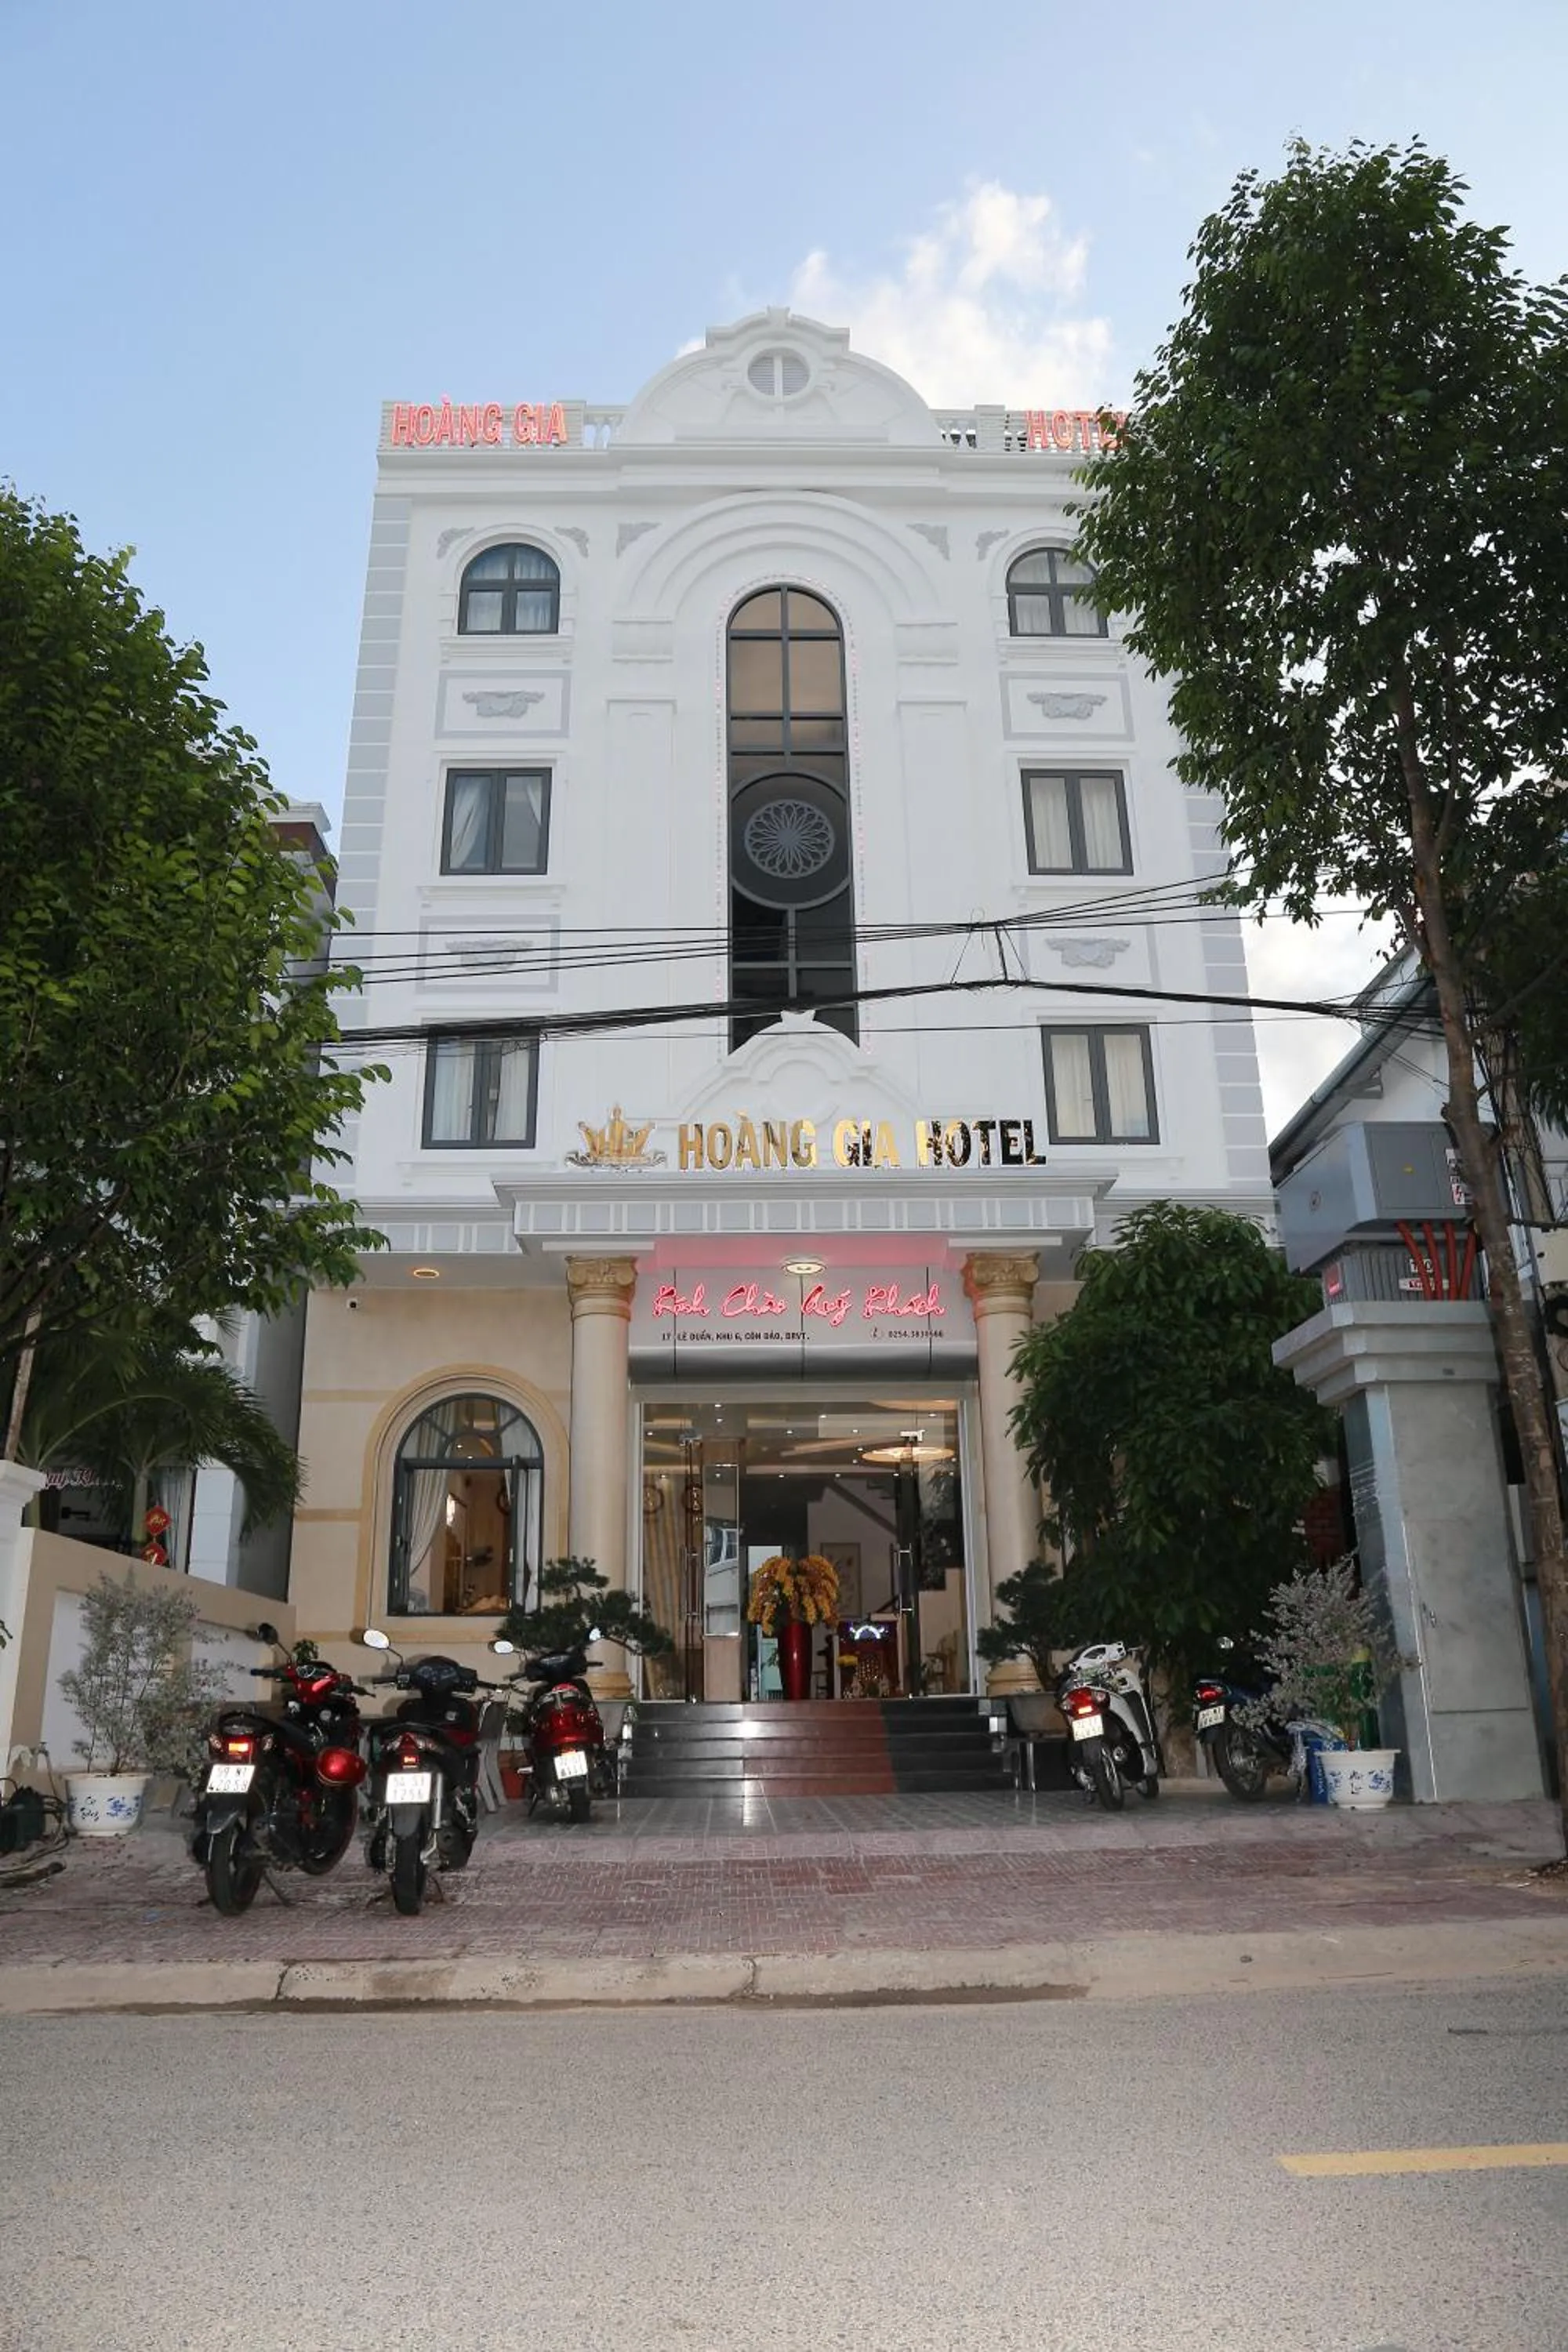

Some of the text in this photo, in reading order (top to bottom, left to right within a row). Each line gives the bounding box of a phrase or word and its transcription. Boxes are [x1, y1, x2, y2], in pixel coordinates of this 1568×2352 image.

[393, 391, 568, 445] HOÀNG GIA
[678, 1110, 1047, 1171] HOÀNG GIA HOTEL
[721, 1283, 788, 1318] Chào
[801, 1285, 851, 1327] Quý
[863, 1283, 946, 1318] Khách
